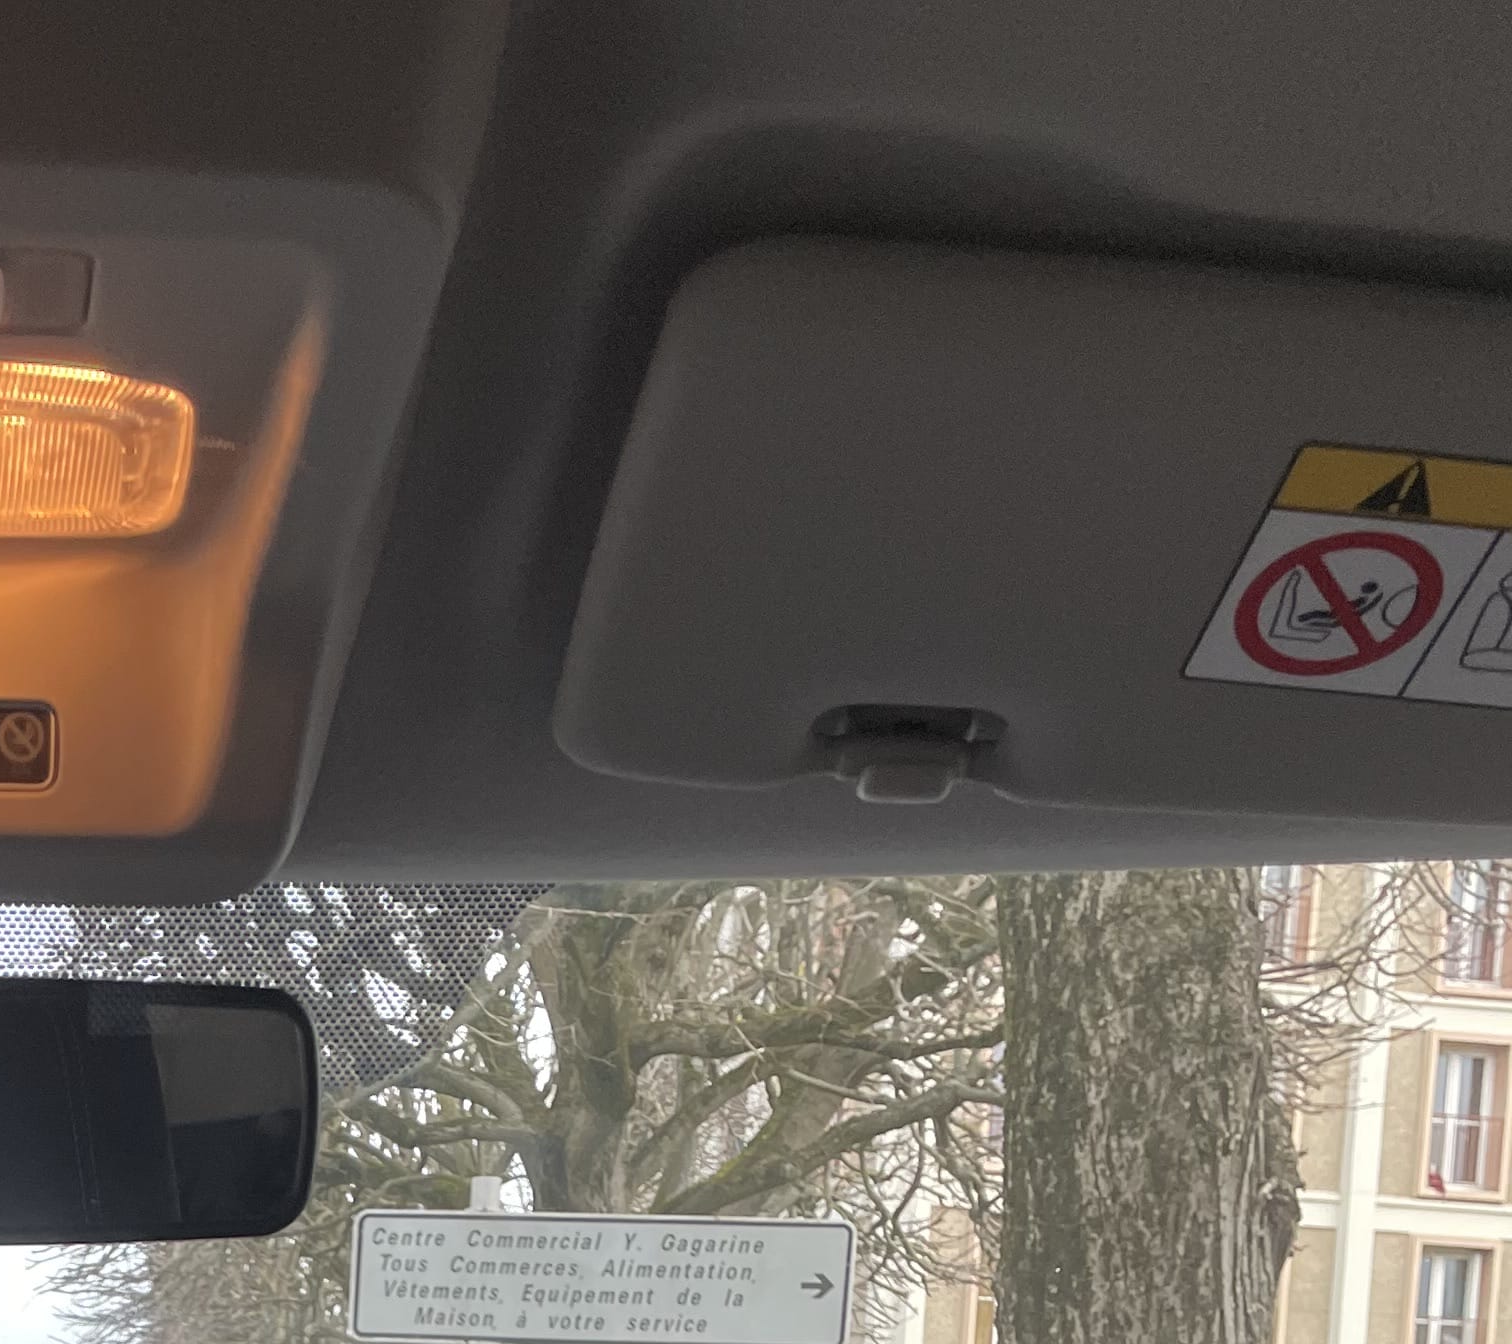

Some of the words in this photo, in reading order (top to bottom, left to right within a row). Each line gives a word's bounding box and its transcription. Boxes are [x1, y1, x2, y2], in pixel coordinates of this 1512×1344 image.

[372, 1227, 446, 1248] Centre
[467, 1229, 602, 1251] Commercial
[624, 1233, 642, 1251] Y.
[661, 1233, 765, 1257] Gagarine
[380, 1254, 429, 1273] Tous
[521, 1283, 655, 1308] Equipement
[676, 1288, 702, 1306] de
[724, 1289, 745, 1307] la
[515, 1310, 527, 1329] à
[548, 1313, 605, 1331] votre
[626, 1315, 708, 1334] service
